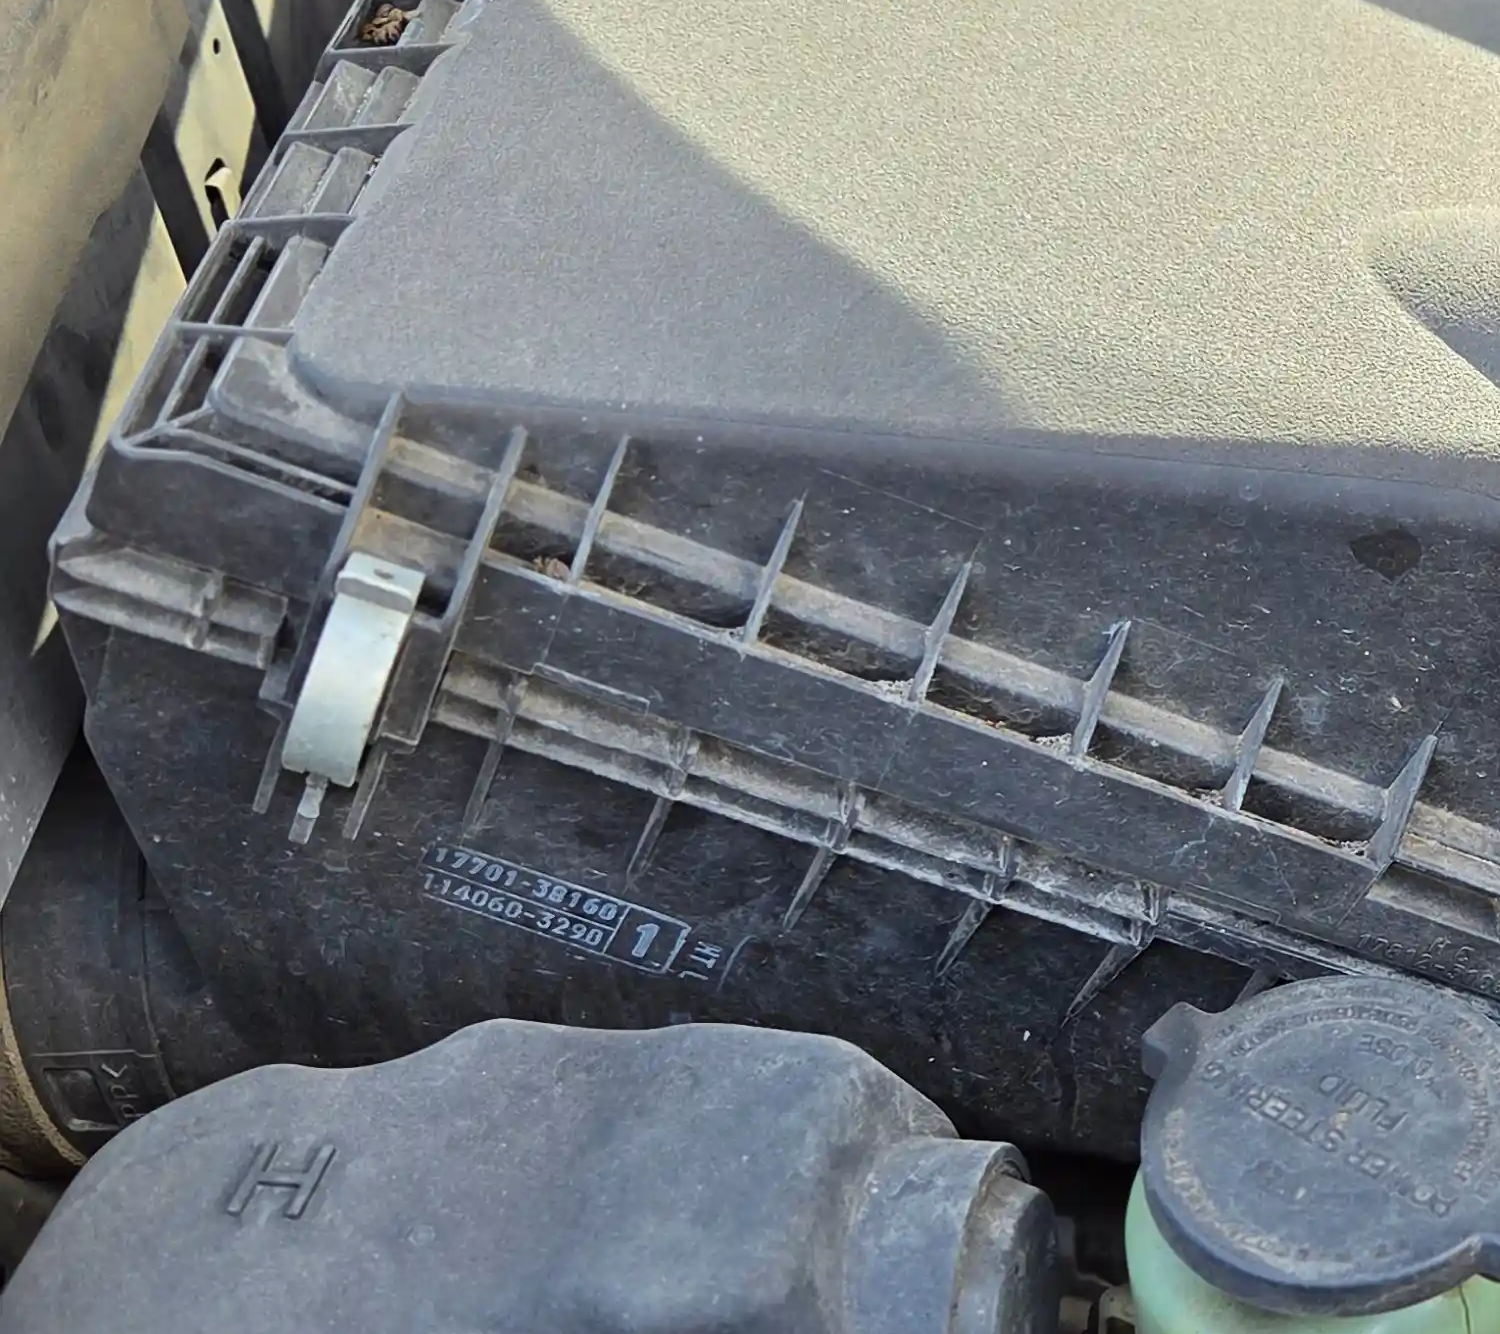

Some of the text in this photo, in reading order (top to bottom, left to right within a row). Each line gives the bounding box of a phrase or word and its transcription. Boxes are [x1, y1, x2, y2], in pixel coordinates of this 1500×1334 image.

[422, 872, 605, 947] 114060-3290
[433, 846, 619, 922] 17701-38160
[631, 922, 660, 958] 1
[1317, 1074, 1409, 1132] FLUID
[226, 1141, 338, 1221] H
